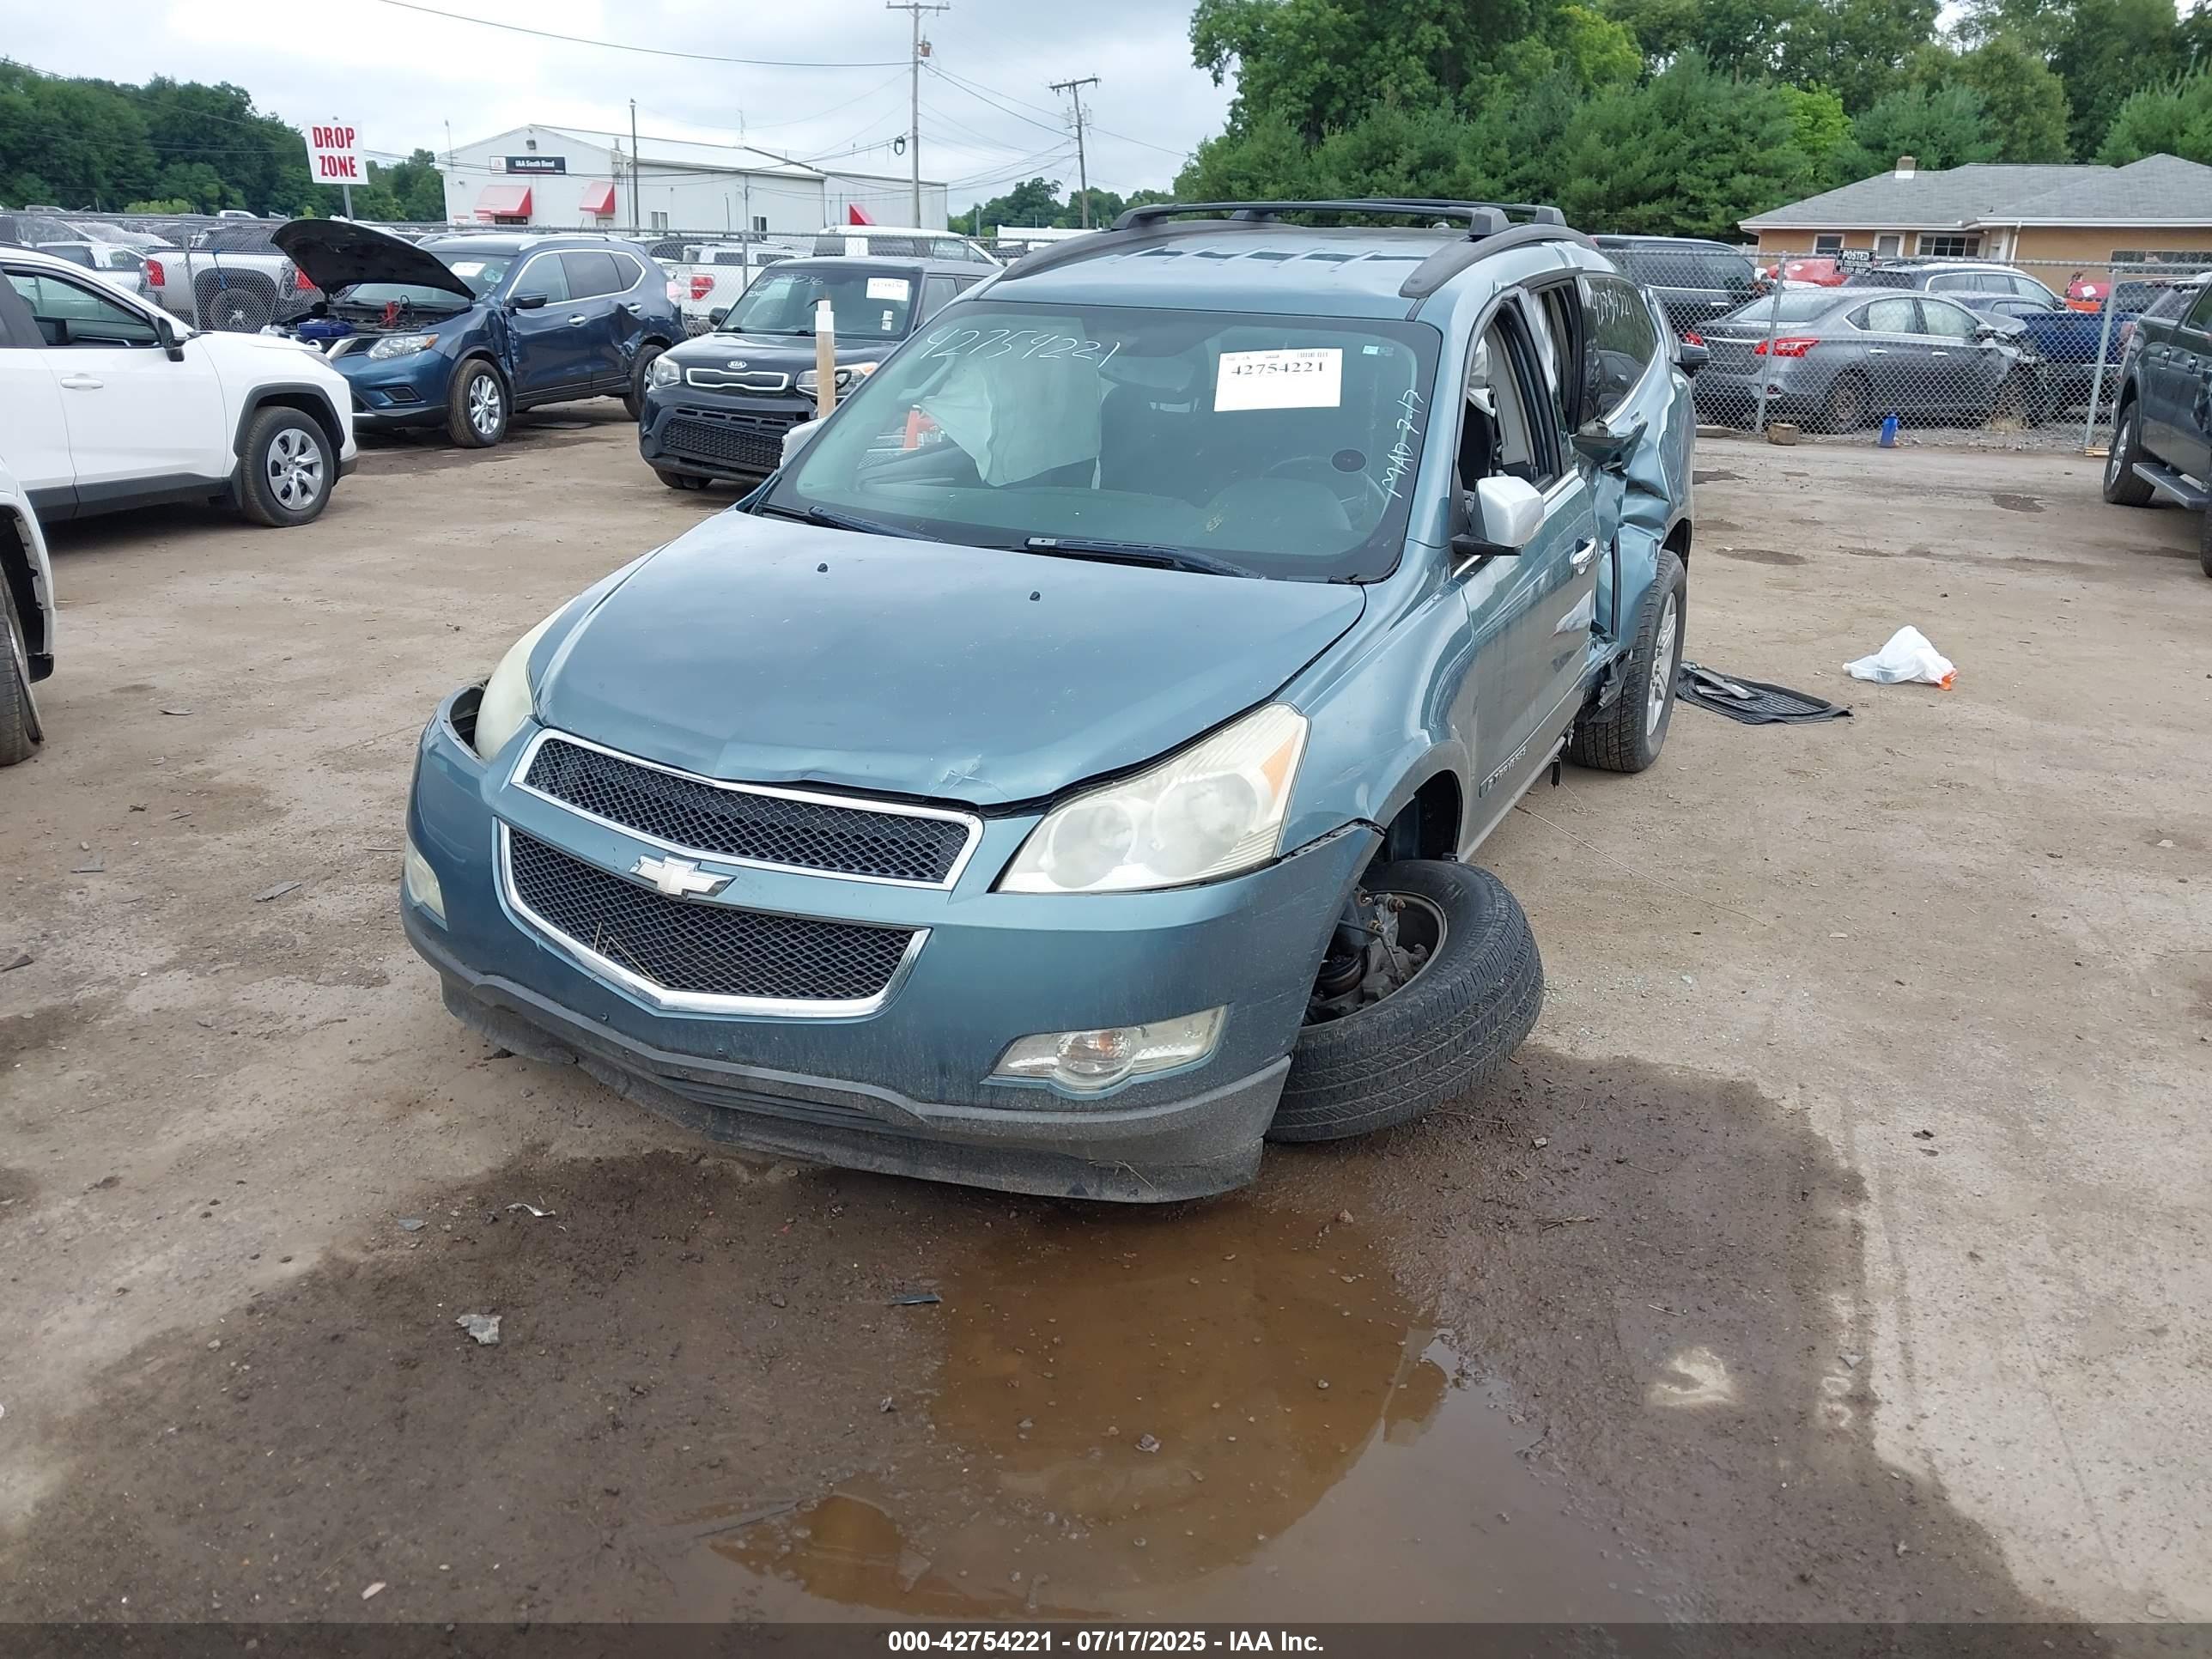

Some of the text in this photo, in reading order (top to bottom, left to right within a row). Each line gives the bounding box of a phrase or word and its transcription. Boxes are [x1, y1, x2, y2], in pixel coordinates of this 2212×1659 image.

[312, 126, 355, 149] DROP
[319, 155, 357, 178] ZONE
[1842, 250, 1870, 261] POSTED
[921, 327, 1121, 368] 42754221
[1231, 362, 1324, 375] 42754221
[1382, 442, 1415, 498] MAD
